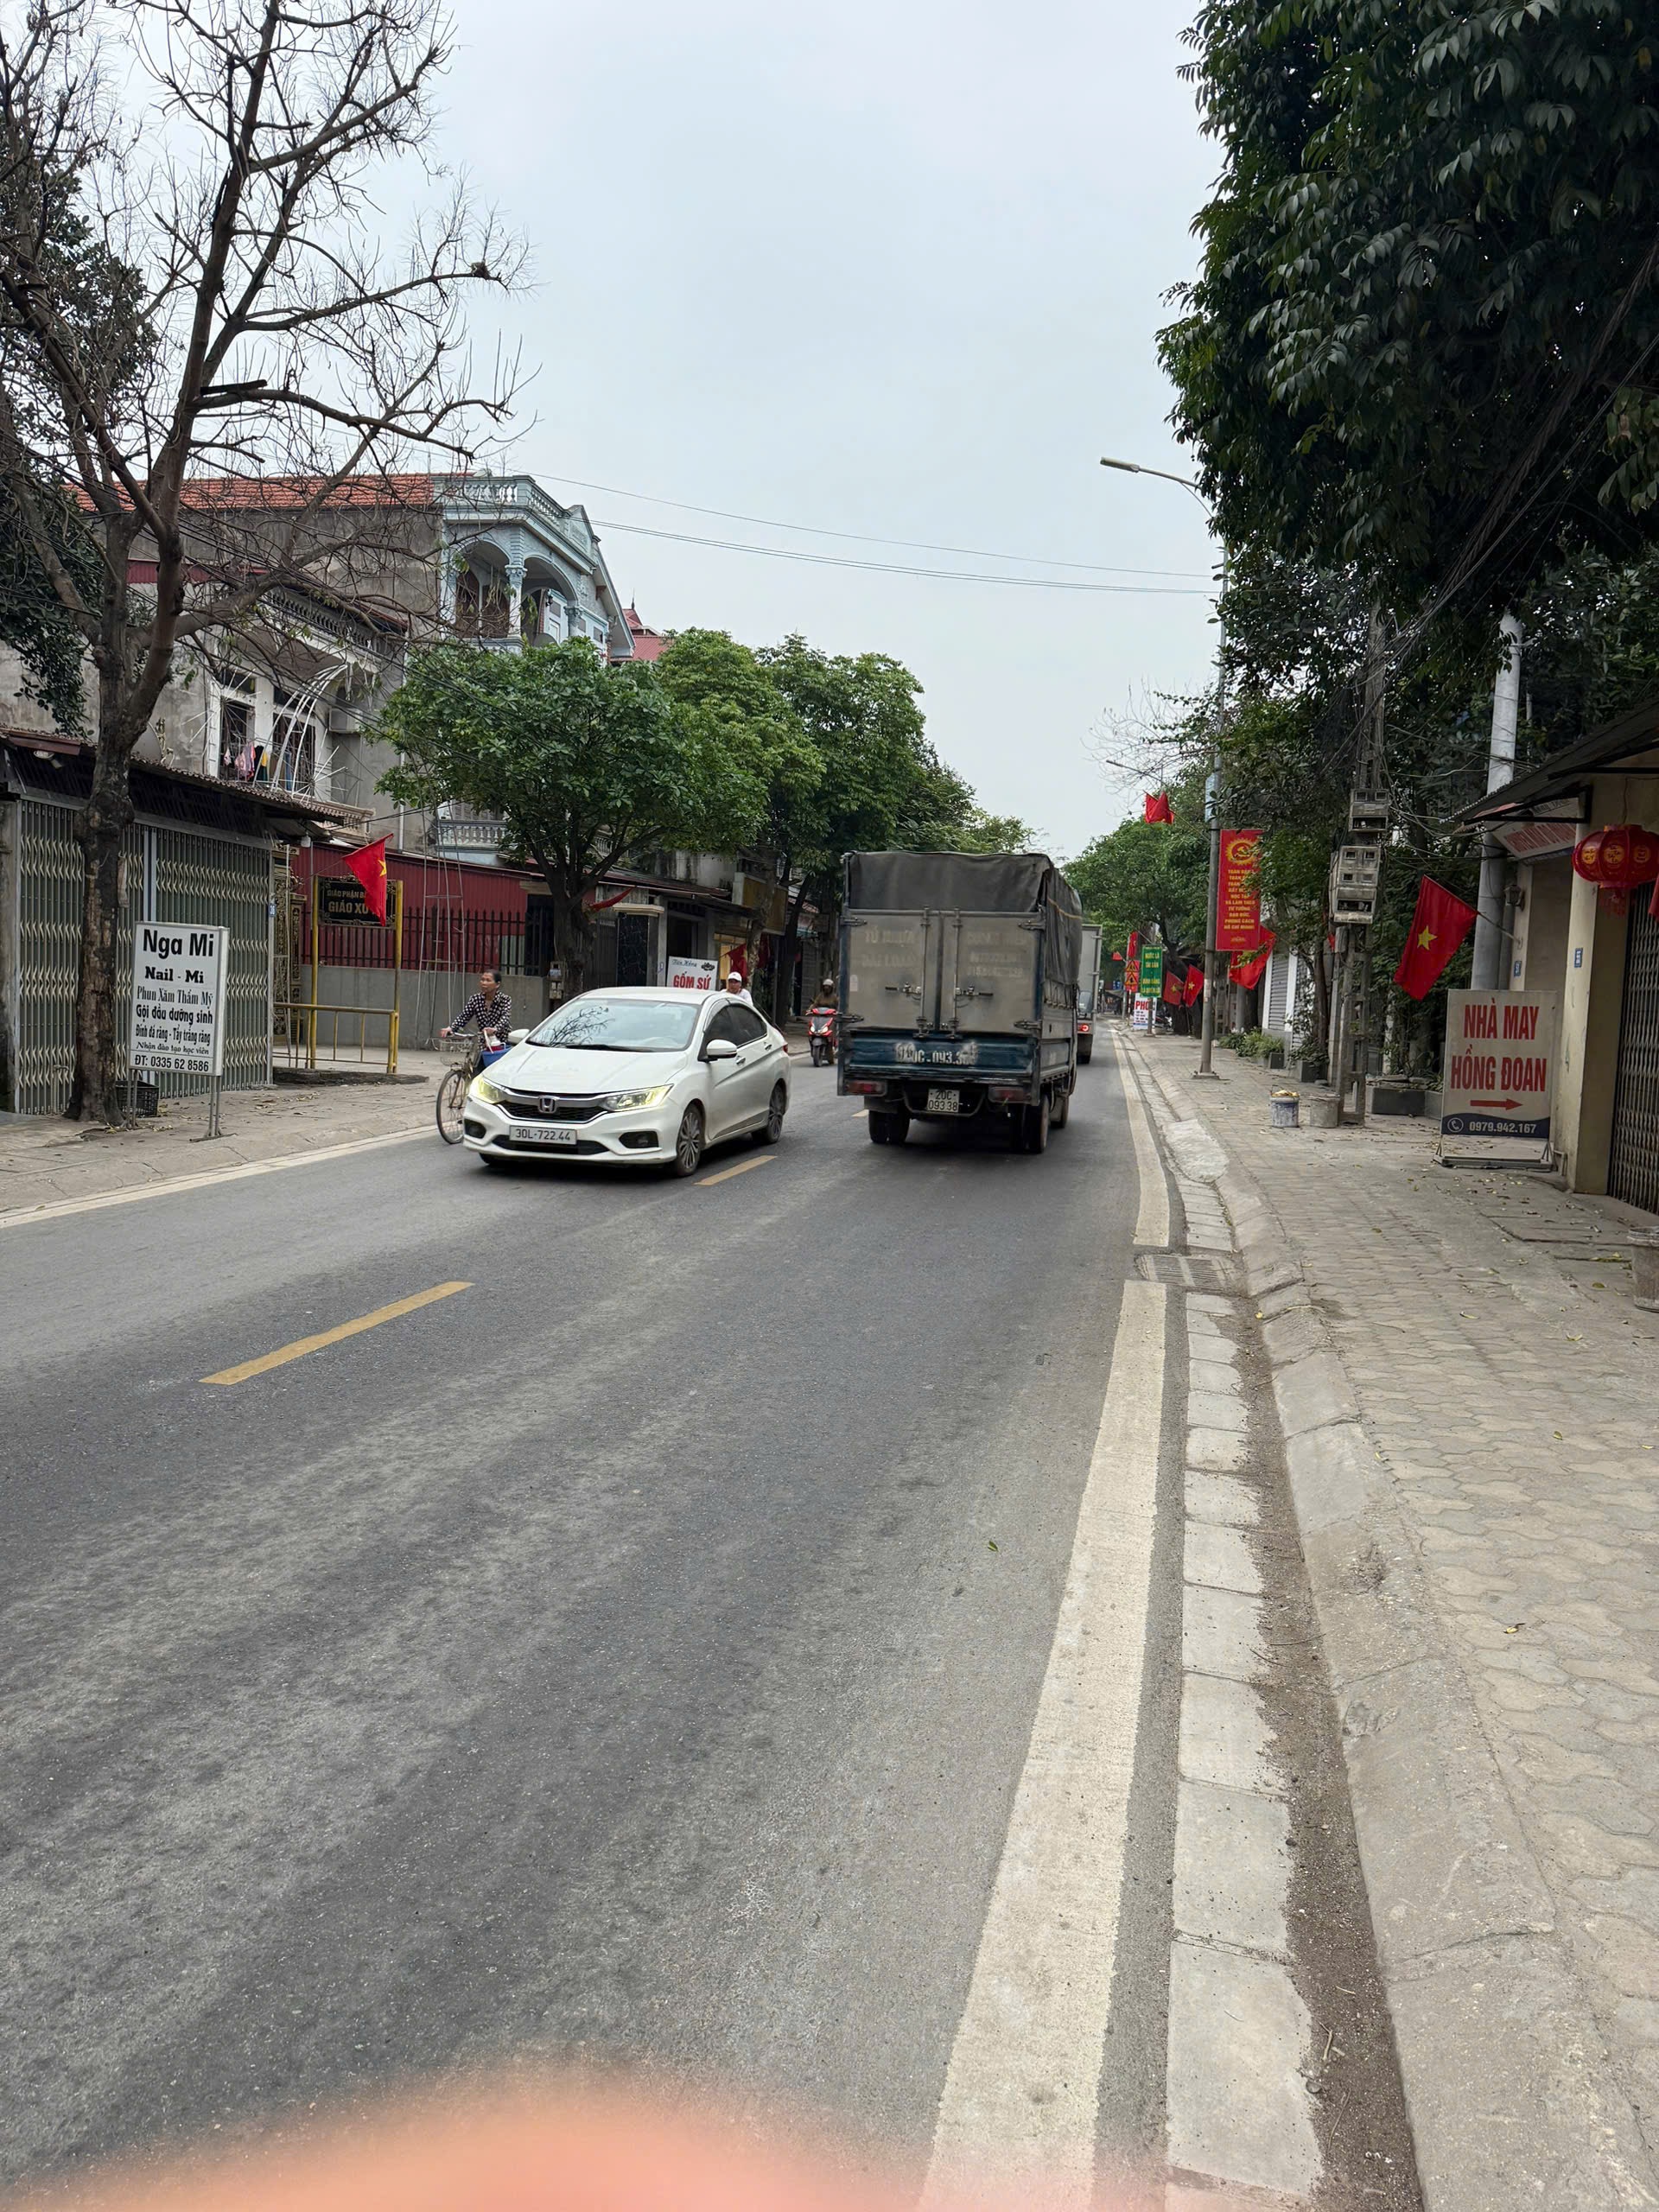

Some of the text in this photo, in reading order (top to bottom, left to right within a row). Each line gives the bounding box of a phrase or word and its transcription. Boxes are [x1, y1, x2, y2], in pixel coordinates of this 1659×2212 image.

[327, 888, 341, 898] GIÁO
[328, 899, 353, 913] GIÁO
[143, 929, 214, 960] Nga Mi
[144, 966, 174, 982] Nail
[185, 969, 204, 984] Mi
[673, 971, 712, 990] GỐM SỨ
[137, 985, 156, 1001] Phun
[157, 988, 175, 1003] Xăm
[200, 991, 213, 1009] Mỹ
[136, 1003, 213, 1026] Gội đầu dưỡng sinh
[1463, 997, 1540, 1040] NHÀ MAY
[134, 1054, 209, 1072] ĐT: 0335 62 8586
[1450, 1044, 1548, 1092] HỒNG ĐOAN
[935, 1090, 953, 1100] 20C
[515, 1128, 570, 1141] 30L-722.44
[1469, 1121, 1537, 1134] 0979.942.167
